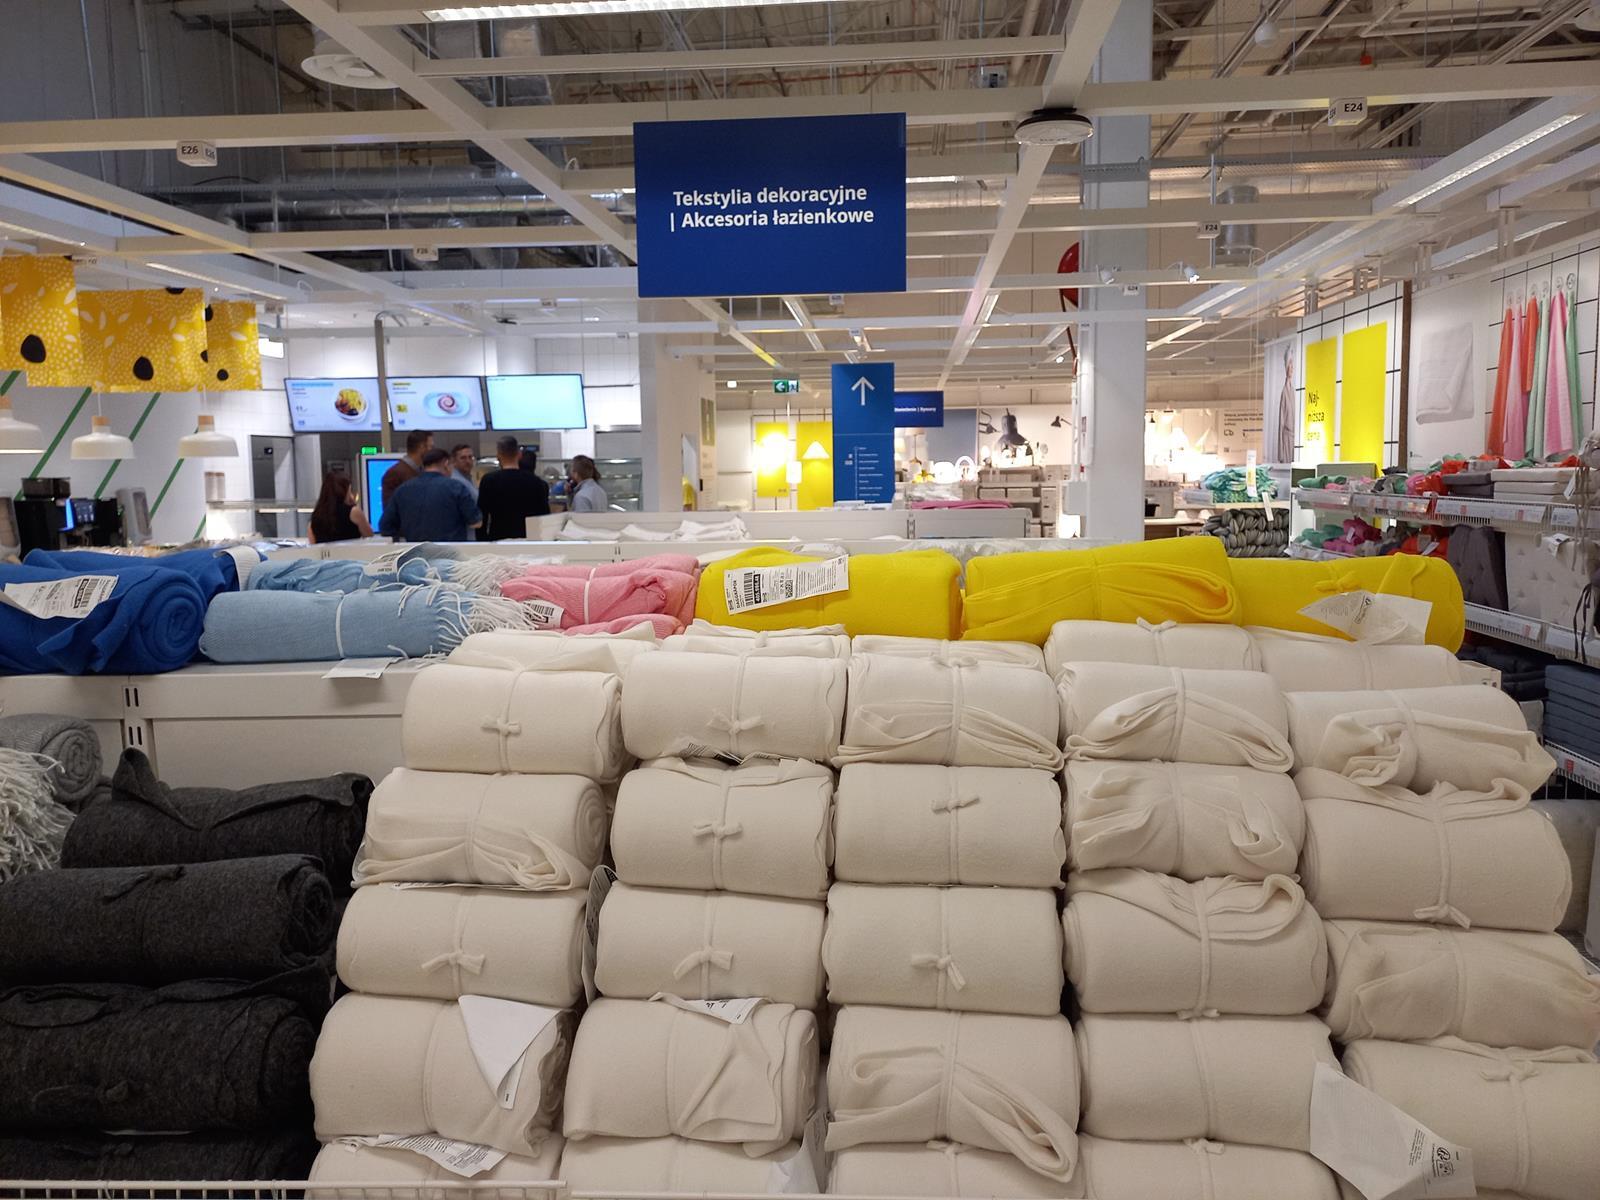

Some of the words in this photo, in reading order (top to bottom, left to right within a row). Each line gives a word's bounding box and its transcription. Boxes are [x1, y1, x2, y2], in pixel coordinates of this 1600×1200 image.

[1344, 102, 1363, 113] E24
[181, 145, 199, 155] E26
[673, 188, 752, 209] Tekstylia
[756, 185, 868, 206] dekoracyjne
[681, 210, 769, 228] Akcesoria
[772, 207, 875, 226] łazienkowe
